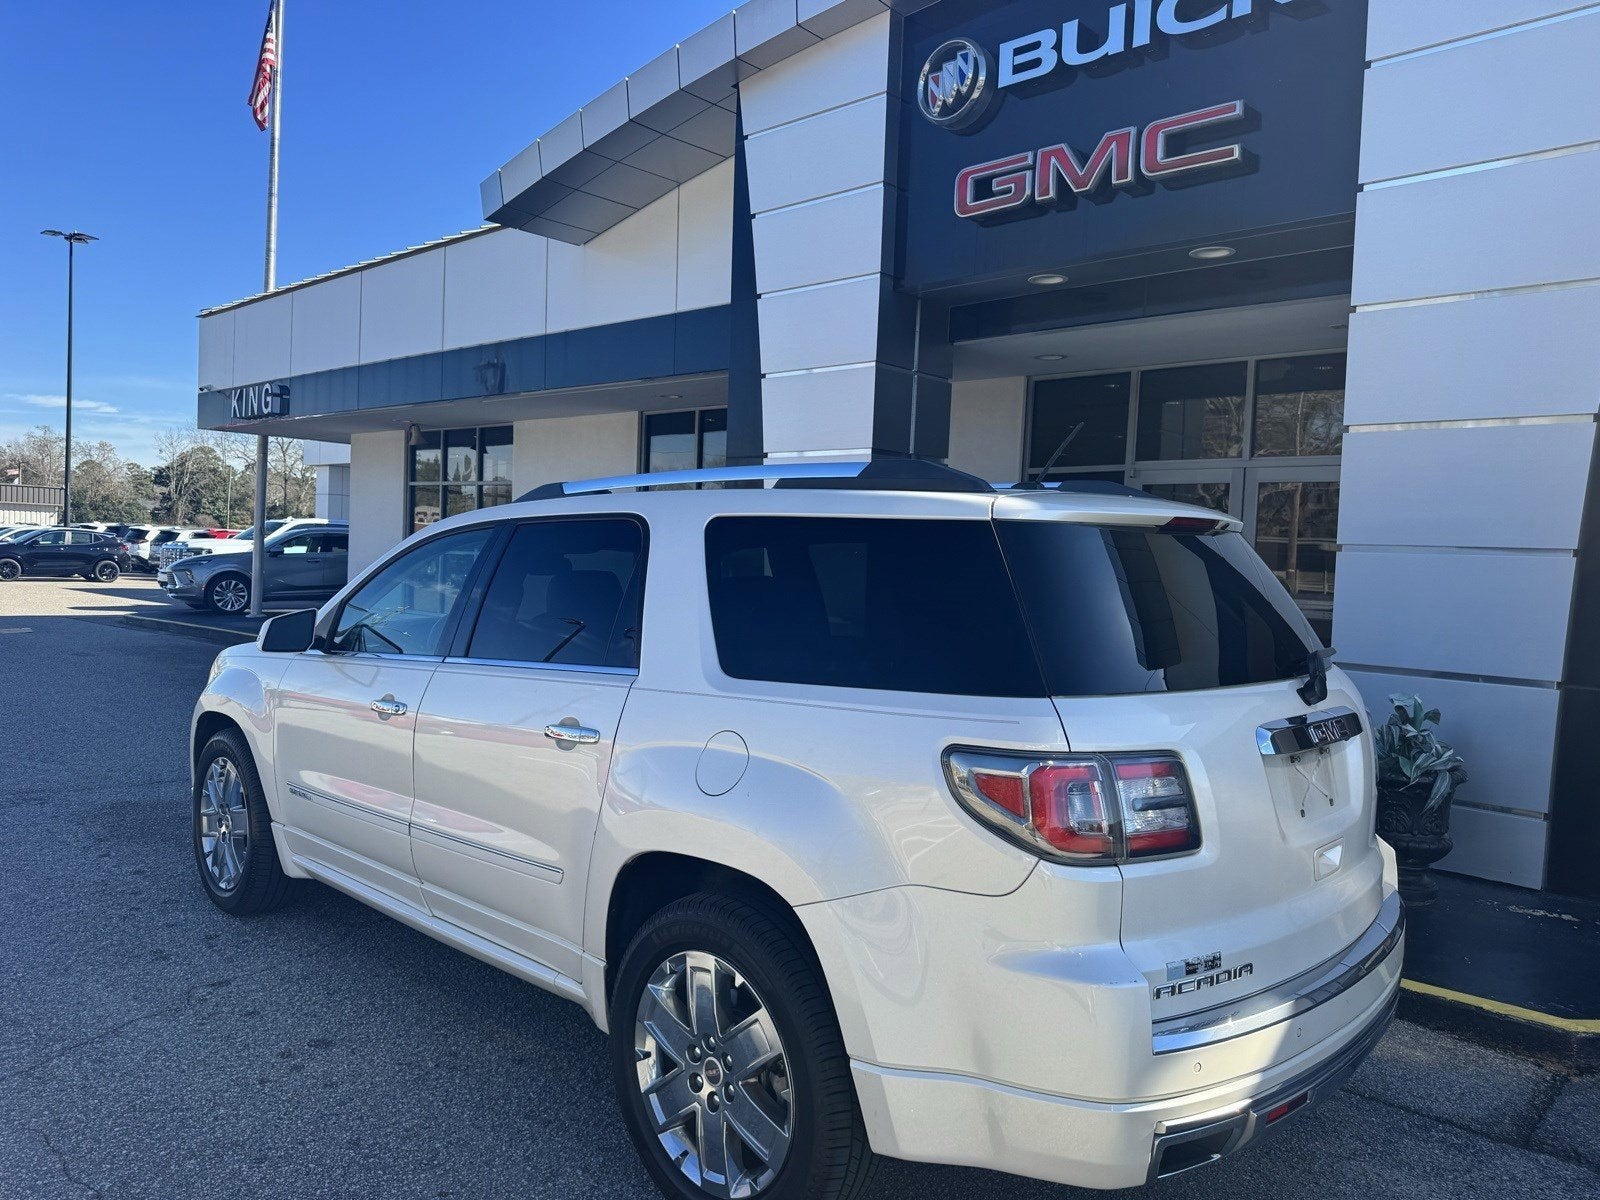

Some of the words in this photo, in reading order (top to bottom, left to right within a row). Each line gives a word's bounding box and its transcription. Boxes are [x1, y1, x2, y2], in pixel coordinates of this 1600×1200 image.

[954, 99, 1243, 218] GMC
[231, 383, 272, 418] KING
[1153, 962, 1254, 1000] ACADIA
